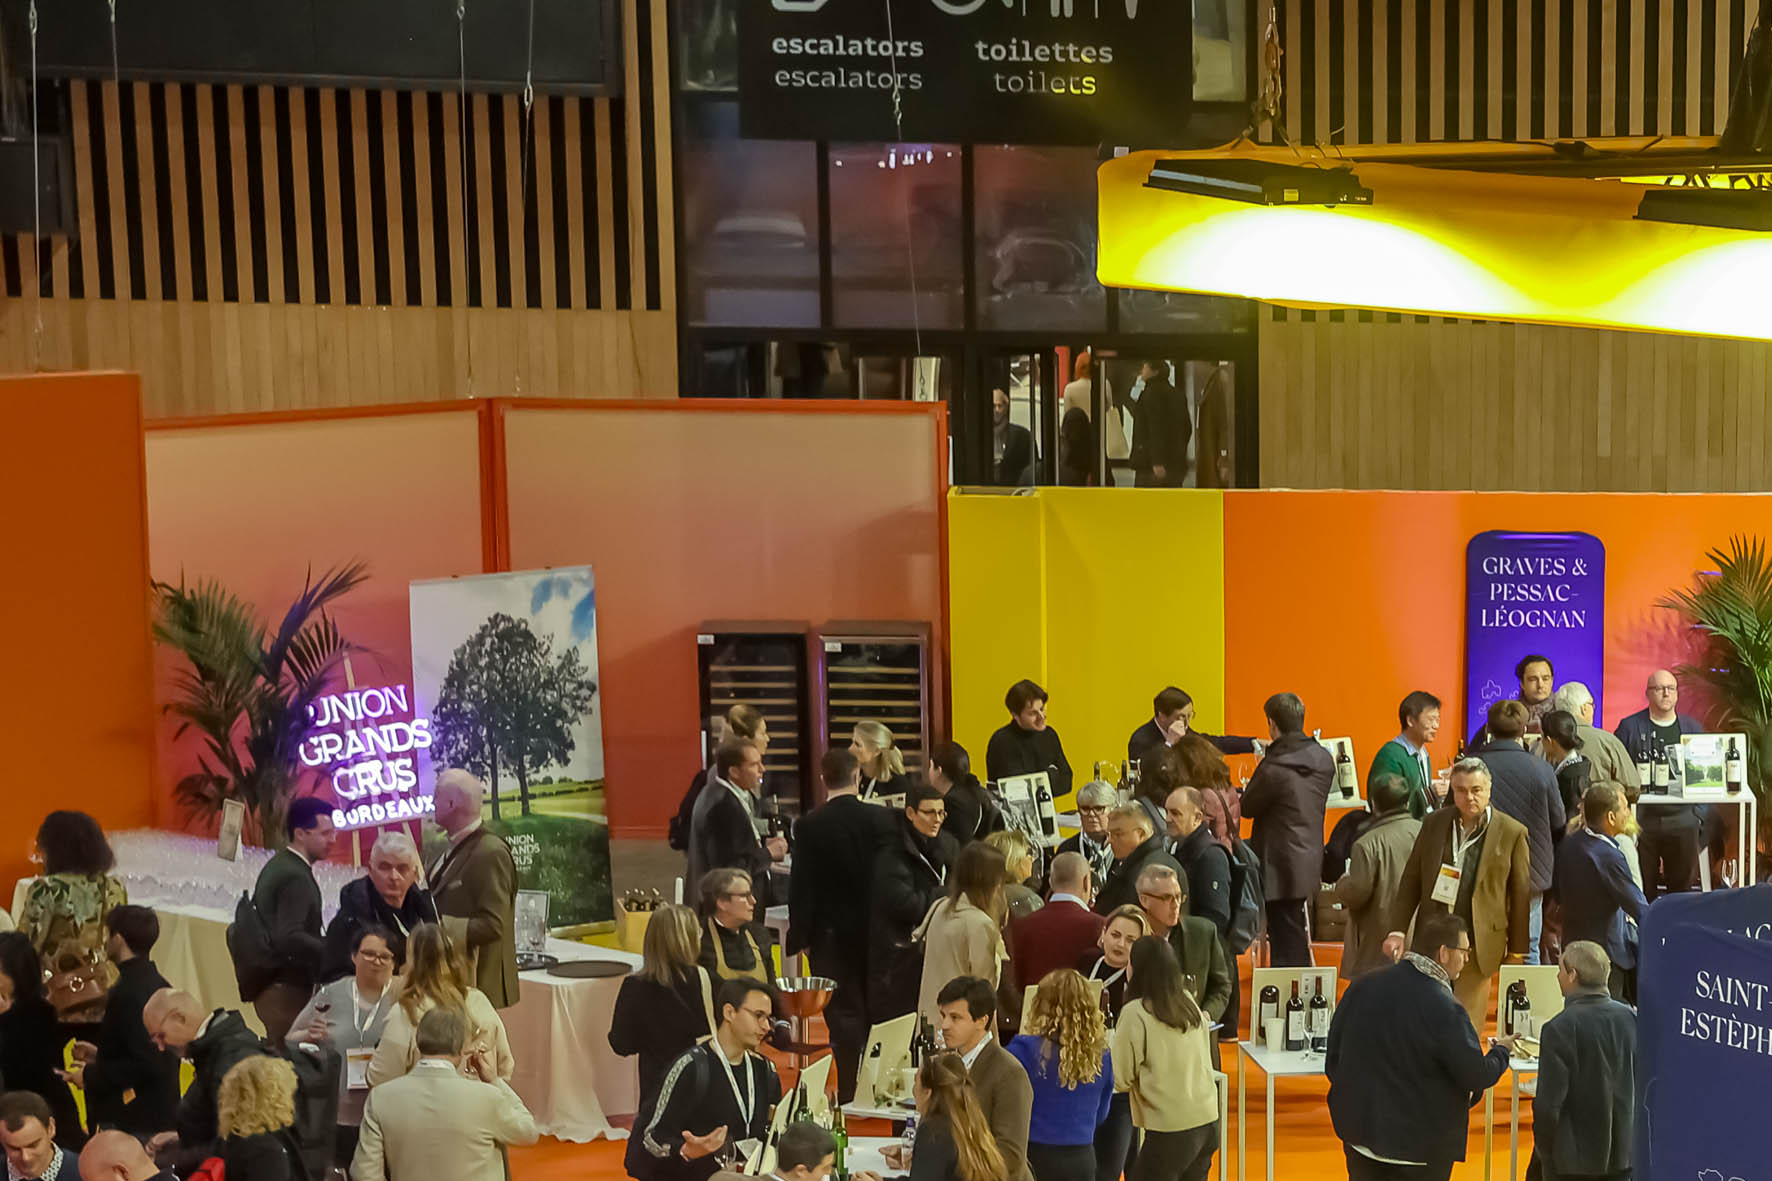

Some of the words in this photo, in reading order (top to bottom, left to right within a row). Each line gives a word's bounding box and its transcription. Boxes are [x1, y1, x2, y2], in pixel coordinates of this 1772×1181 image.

[772, 35, 924, 57] escalators
[975, 38, 1113, 63] toilettes
[775, 68, 922, 89] escalators
[994, 70, 1096, 94] toilets
[1482, 556, 1566, 576] GRAVES
[1571, 558, 1588, 576] &
[1490, 582, 1579, 602] PESSAC-
[1481, 604, 1586, 628] LÉOGNAN
[305, 684, 409, 727] UNION
[298, 718, 433, 766] GRANDS
[333, 757, 417, 800] CRUS
[511, 842, 541, 856] ANDS
[513, 854, 533, 865] RUS
